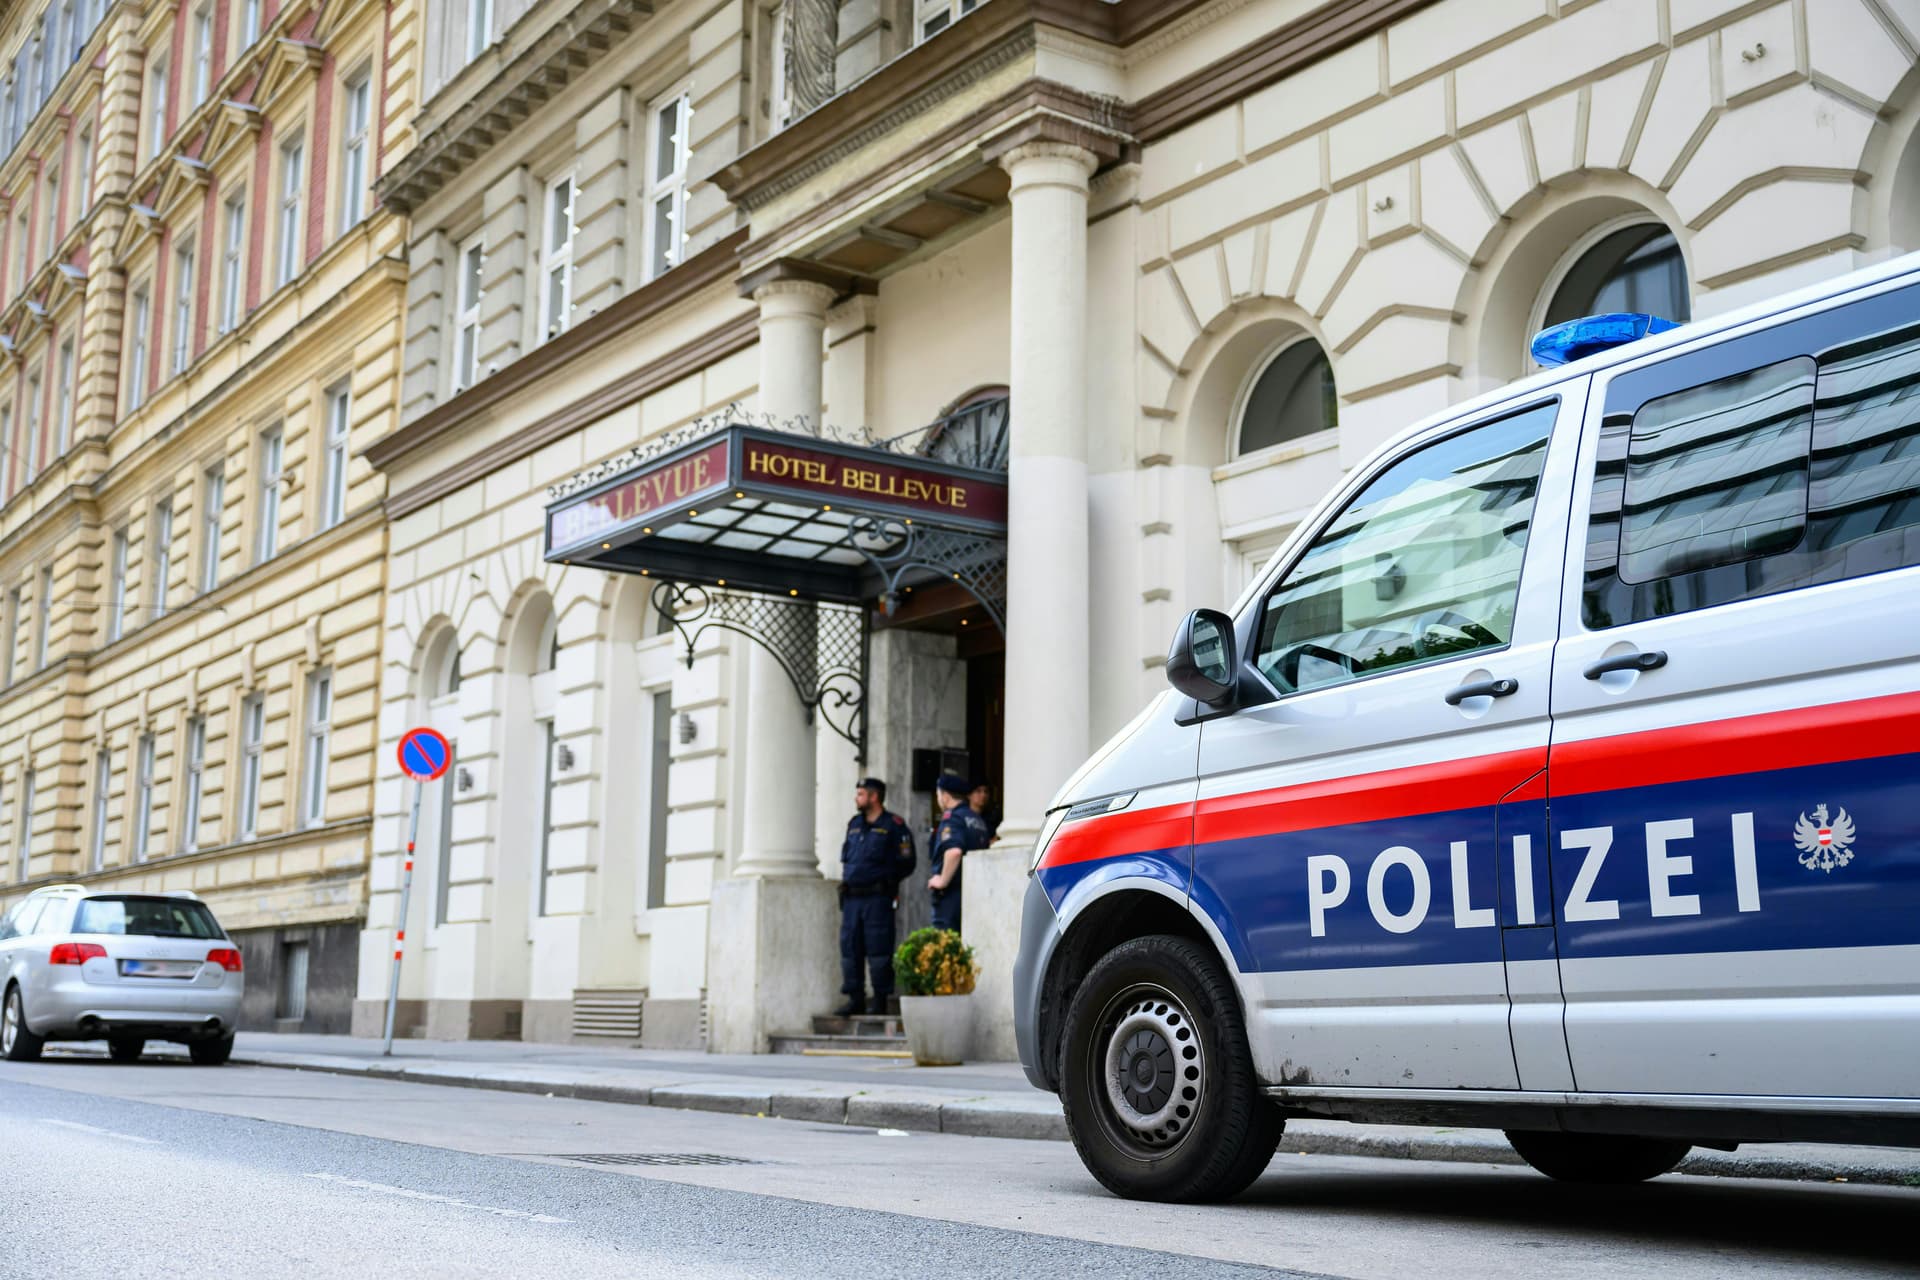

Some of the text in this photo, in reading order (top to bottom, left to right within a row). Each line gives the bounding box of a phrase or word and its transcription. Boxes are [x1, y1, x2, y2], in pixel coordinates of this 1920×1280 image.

[750, 451, 967, 508] HOTEL BELLEVUE
[1307, 812, 1761, 937] POLIZEI
